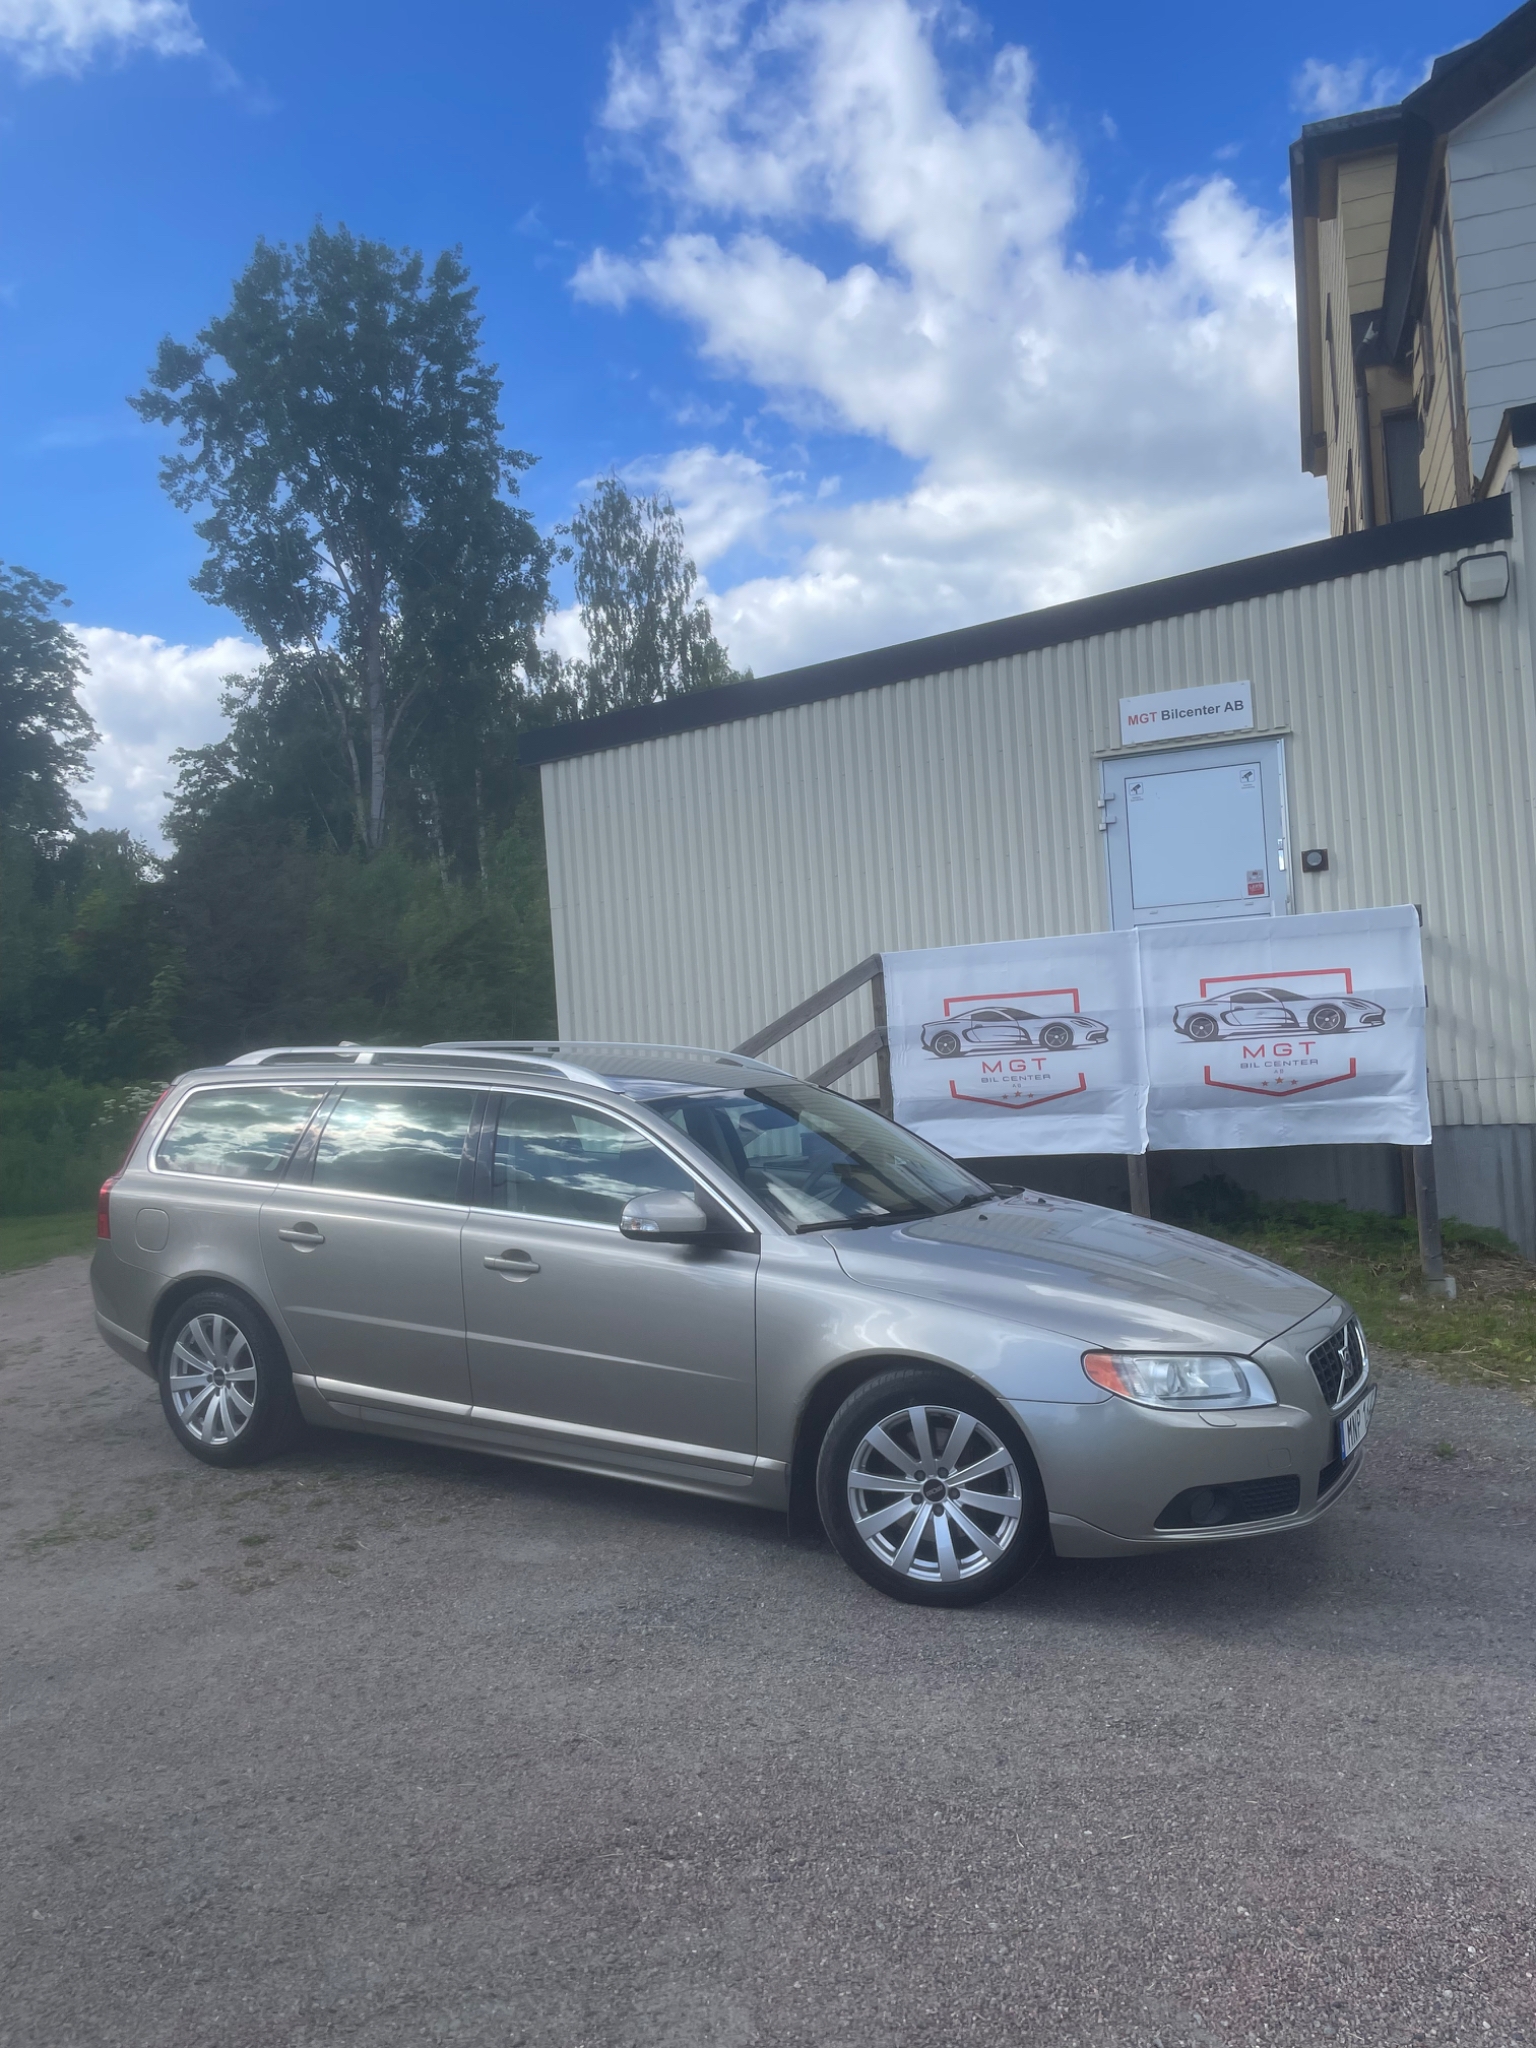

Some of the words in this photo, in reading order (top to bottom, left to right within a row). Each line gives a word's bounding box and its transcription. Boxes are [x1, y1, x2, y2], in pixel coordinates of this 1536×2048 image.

[1127, 711, 1158, 726] MGT
[1161, 704, 1221, 721] Bilcenter
[1223, 700, 1245, 713] AB
[1242, 1041, 1316, 1059] MGT
[981, 1057, 1047, 1074] MGT
[1264, 1058, 1319, 1068] CENTER
[980, 1076, 1000, 1084] BIL
[1002, 1073, 1051, 1082] CENTER
